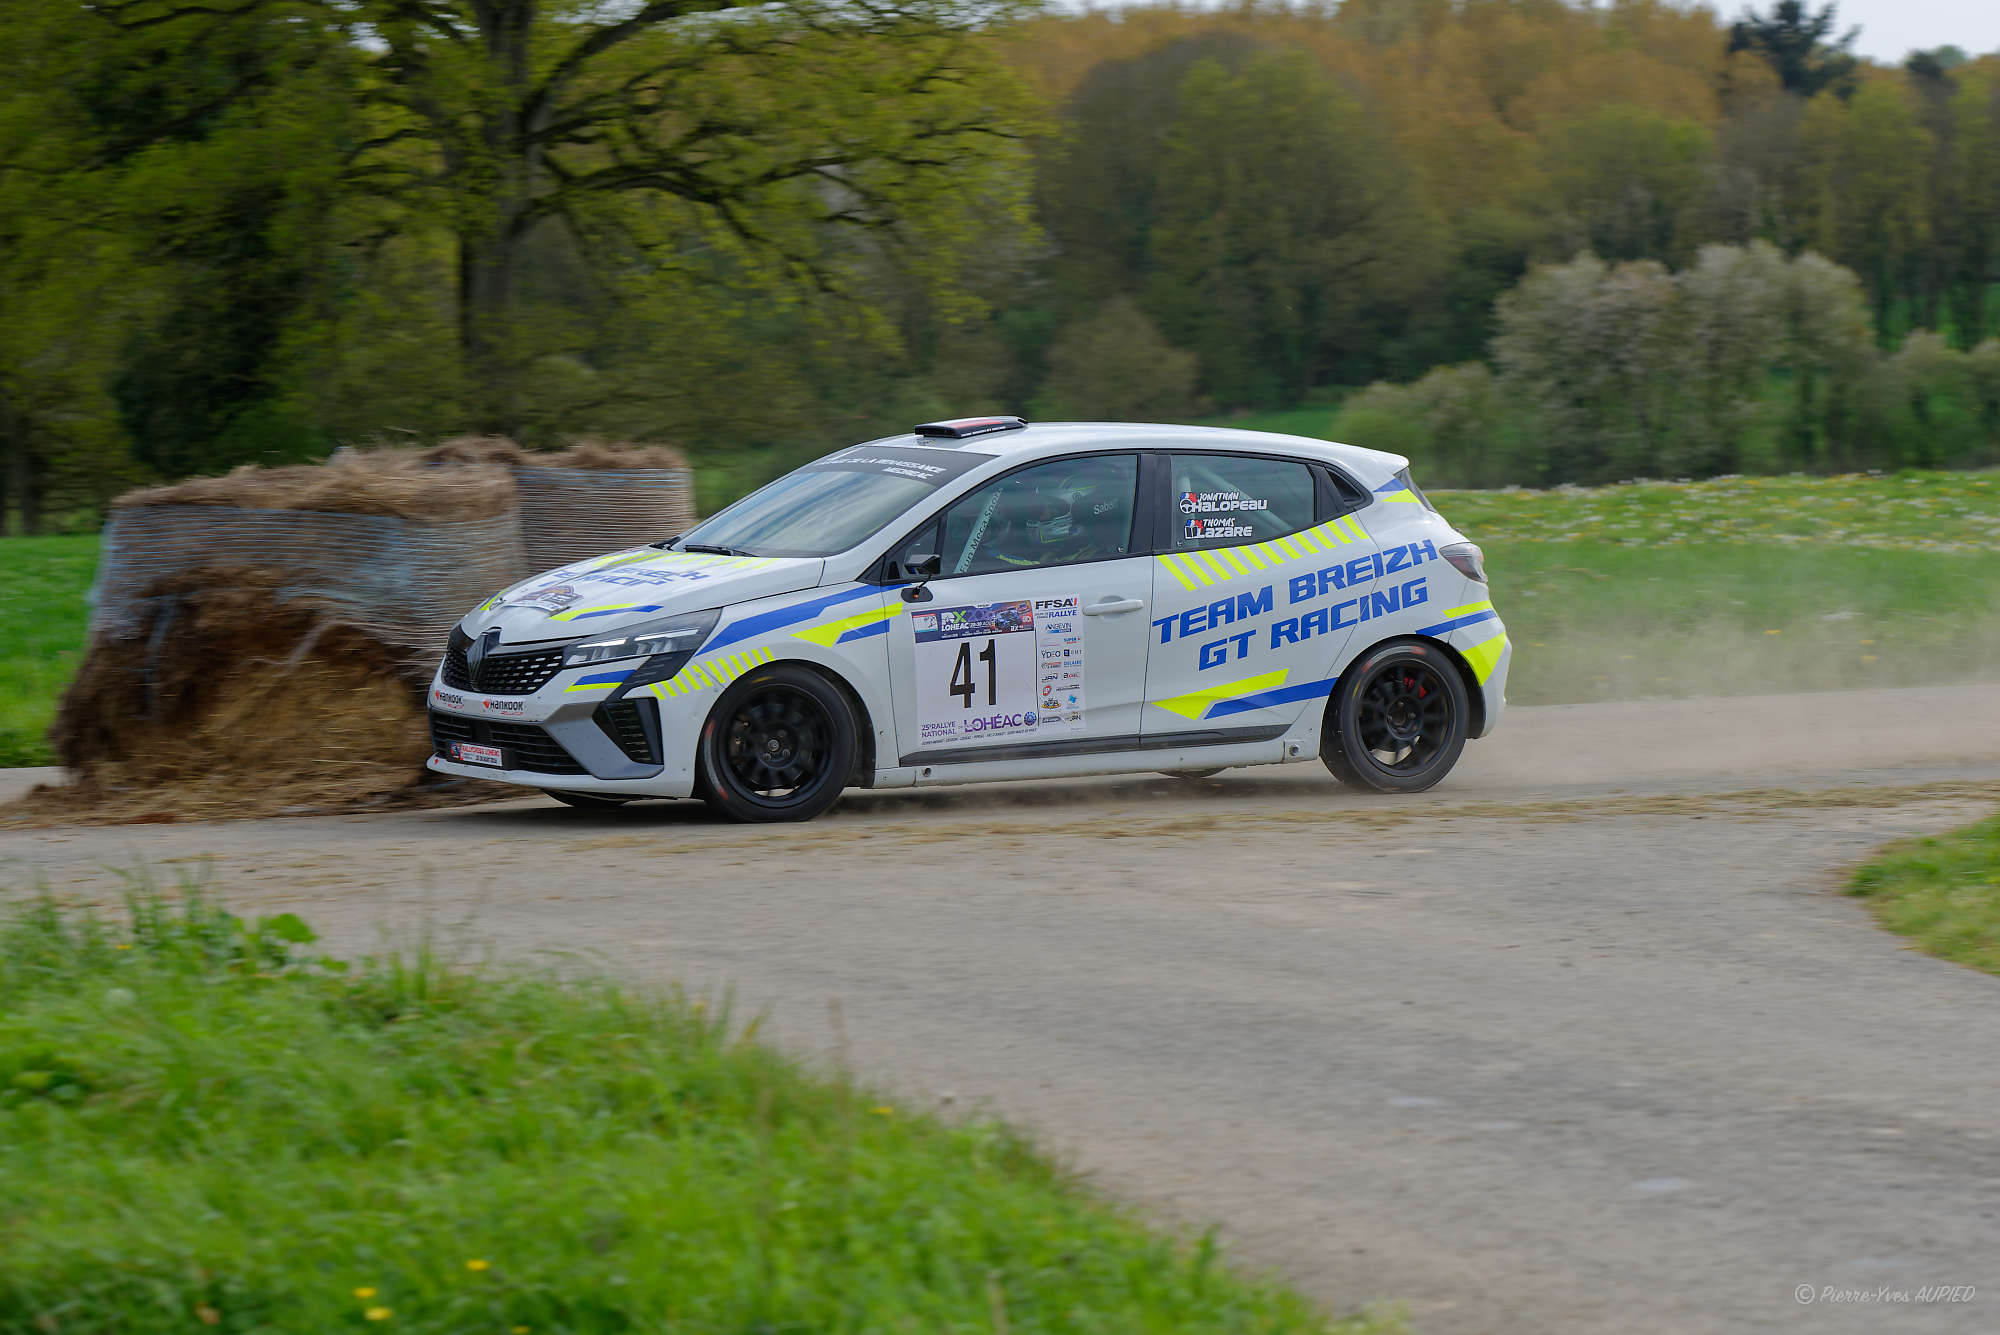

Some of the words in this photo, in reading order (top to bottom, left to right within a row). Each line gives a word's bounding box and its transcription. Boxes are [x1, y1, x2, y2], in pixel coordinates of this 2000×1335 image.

[1199, 492, 1240, 502] JONATHAN
[1202, 517, 1236, 527] THOMAS
[1152, 585, 1273, 644] TEAM
[1289, 539, 1438, 605] BREIZH
[1035, 598, 1074, 610] FFSA
[1049, 609, 1077, 618] RALLYE
[941, 622, 970, 632] LOHEAC
[1198, 629, 1257, 671] GT
[1270, 576, 1428, 650] RACING
[949, 639, 997, 708] 41
[963, 713, 1022, 733] LOHÉAC
[921, 728, 957, 739] NATIONAL
